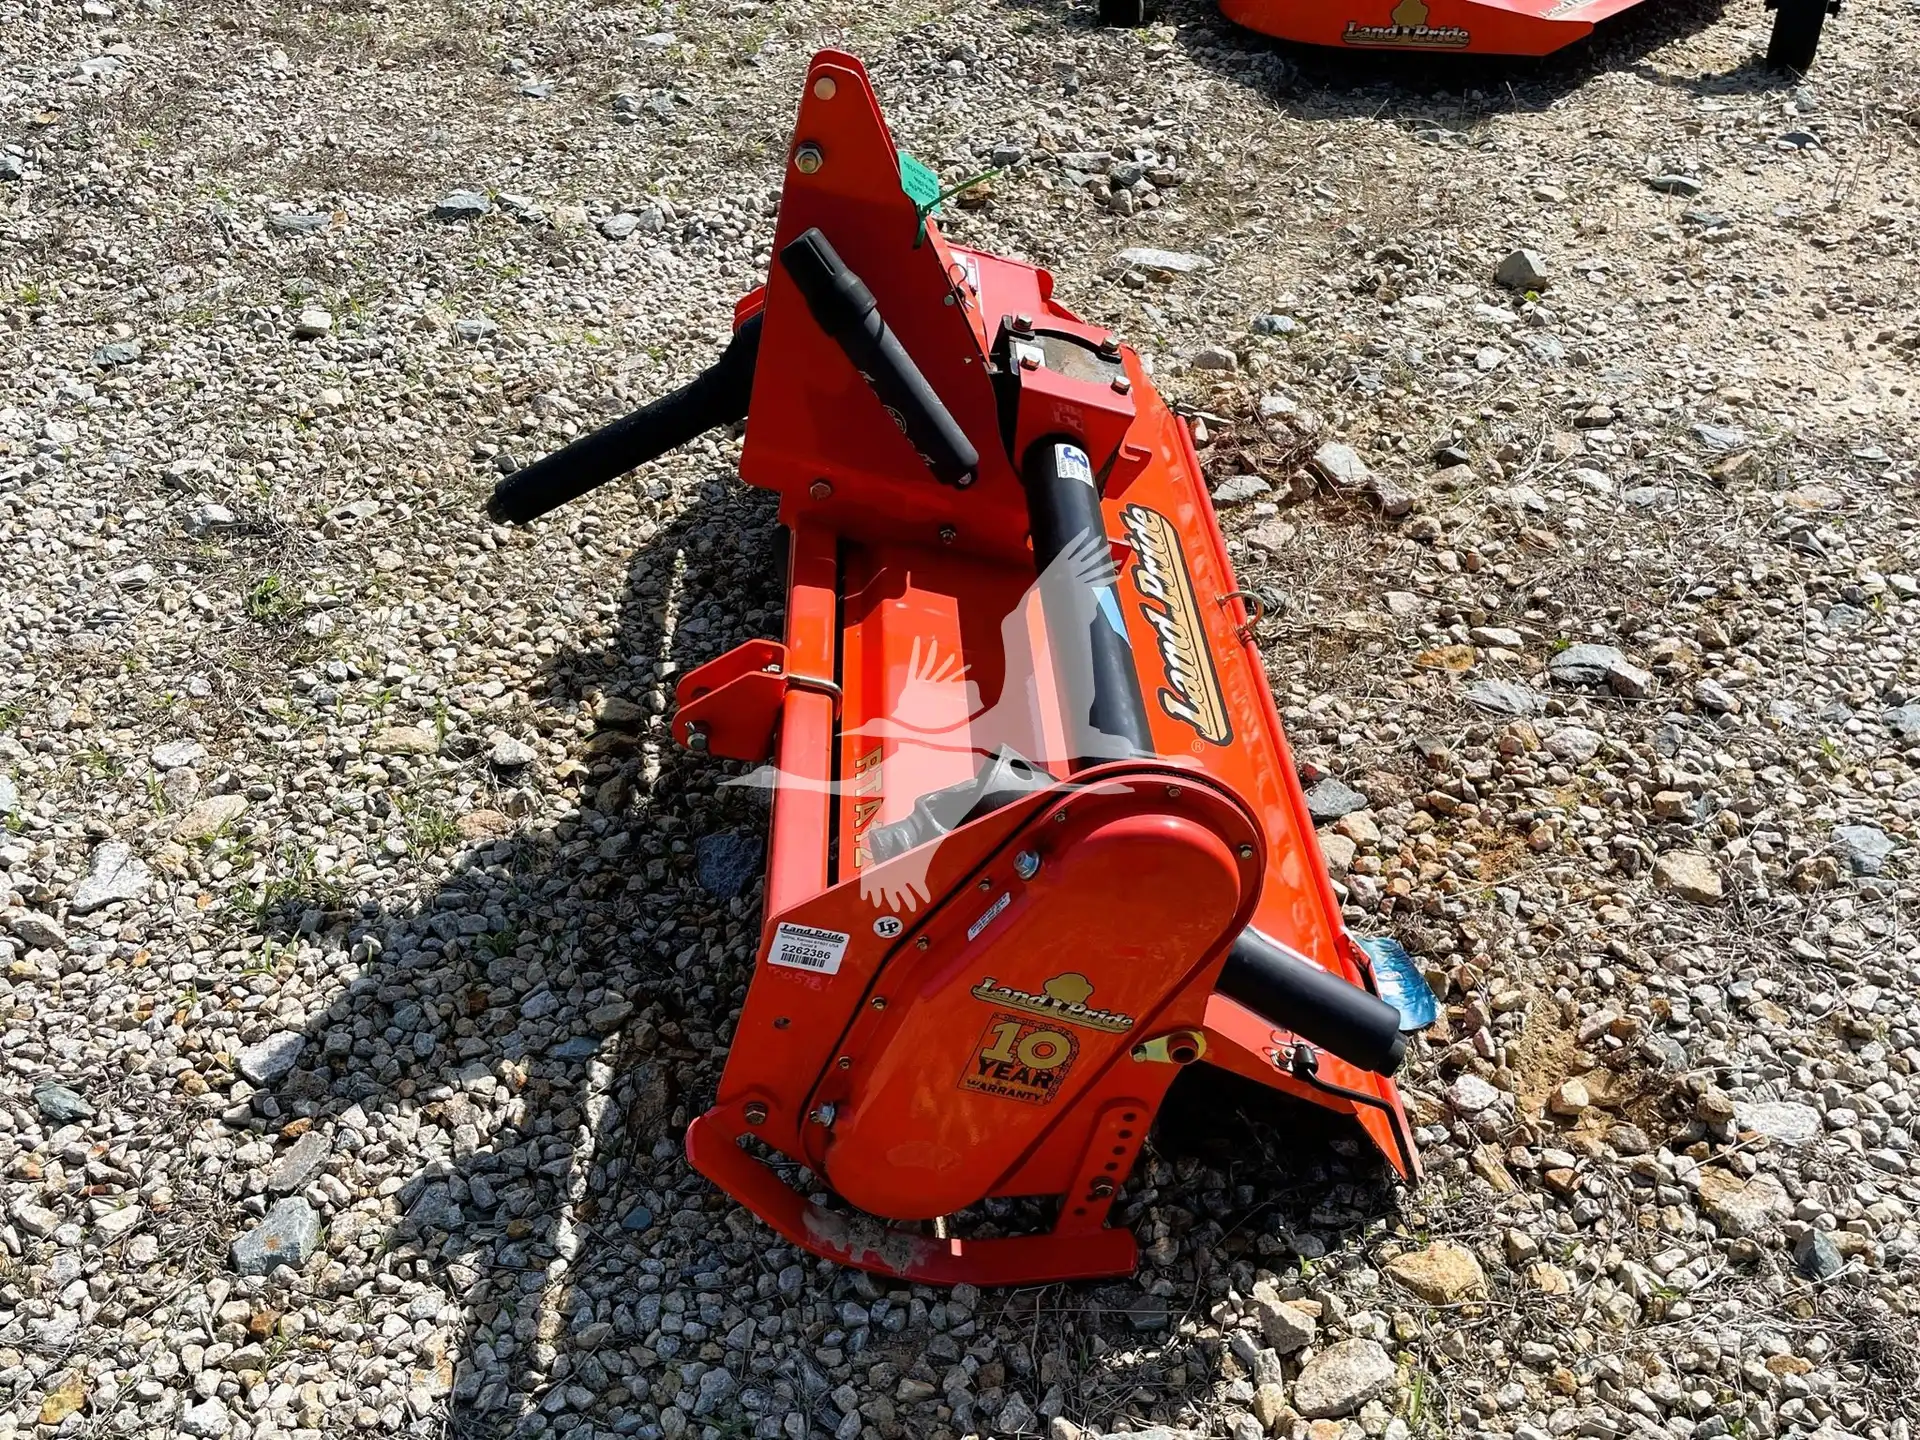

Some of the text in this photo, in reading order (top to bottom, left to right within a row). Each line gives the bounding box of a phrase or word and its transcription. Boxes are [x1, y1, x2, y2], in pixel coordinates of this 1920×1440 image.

[1344, 21, 1470, 43] Land Pride
[1123, 505, 1212, 738] Land Pride
[780, 924, 845, 942] Land Pride
[781, 944, 831, 960] 2262386
[976, 977, 1134, 1030] Land Pride
[980, 1021, 1072, 1070] 10
[979, 1056, 1055, 1089] YEAR
[966, 1079, 1043, 1101] WARRANTY
